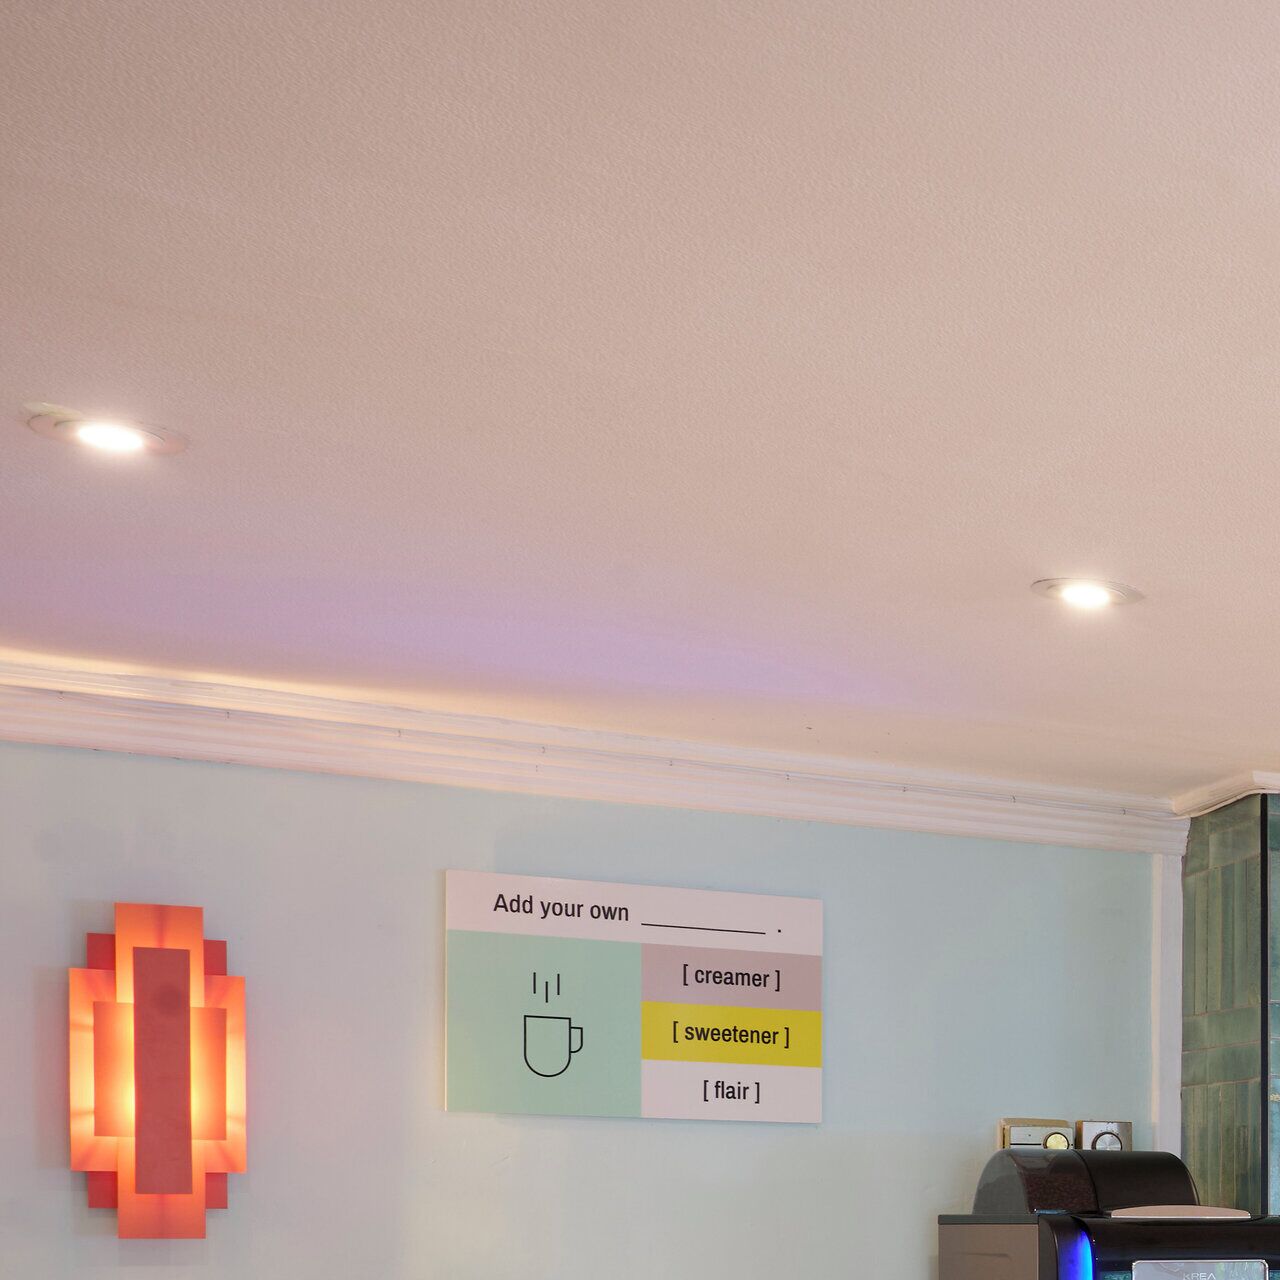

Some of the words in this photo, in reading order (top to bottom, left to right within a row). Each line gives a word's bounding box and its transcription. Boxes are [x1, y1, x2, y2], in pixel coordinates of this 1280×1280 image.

[493, 893, 533, 915] Add
[540, 901, 584, 920] your
[589, 904, 629, 922] own
[694, 966, 770, 989] creamer
[684, 1024, 780, 1045] sweetener
[714, 1080, 750, 1101] flair
